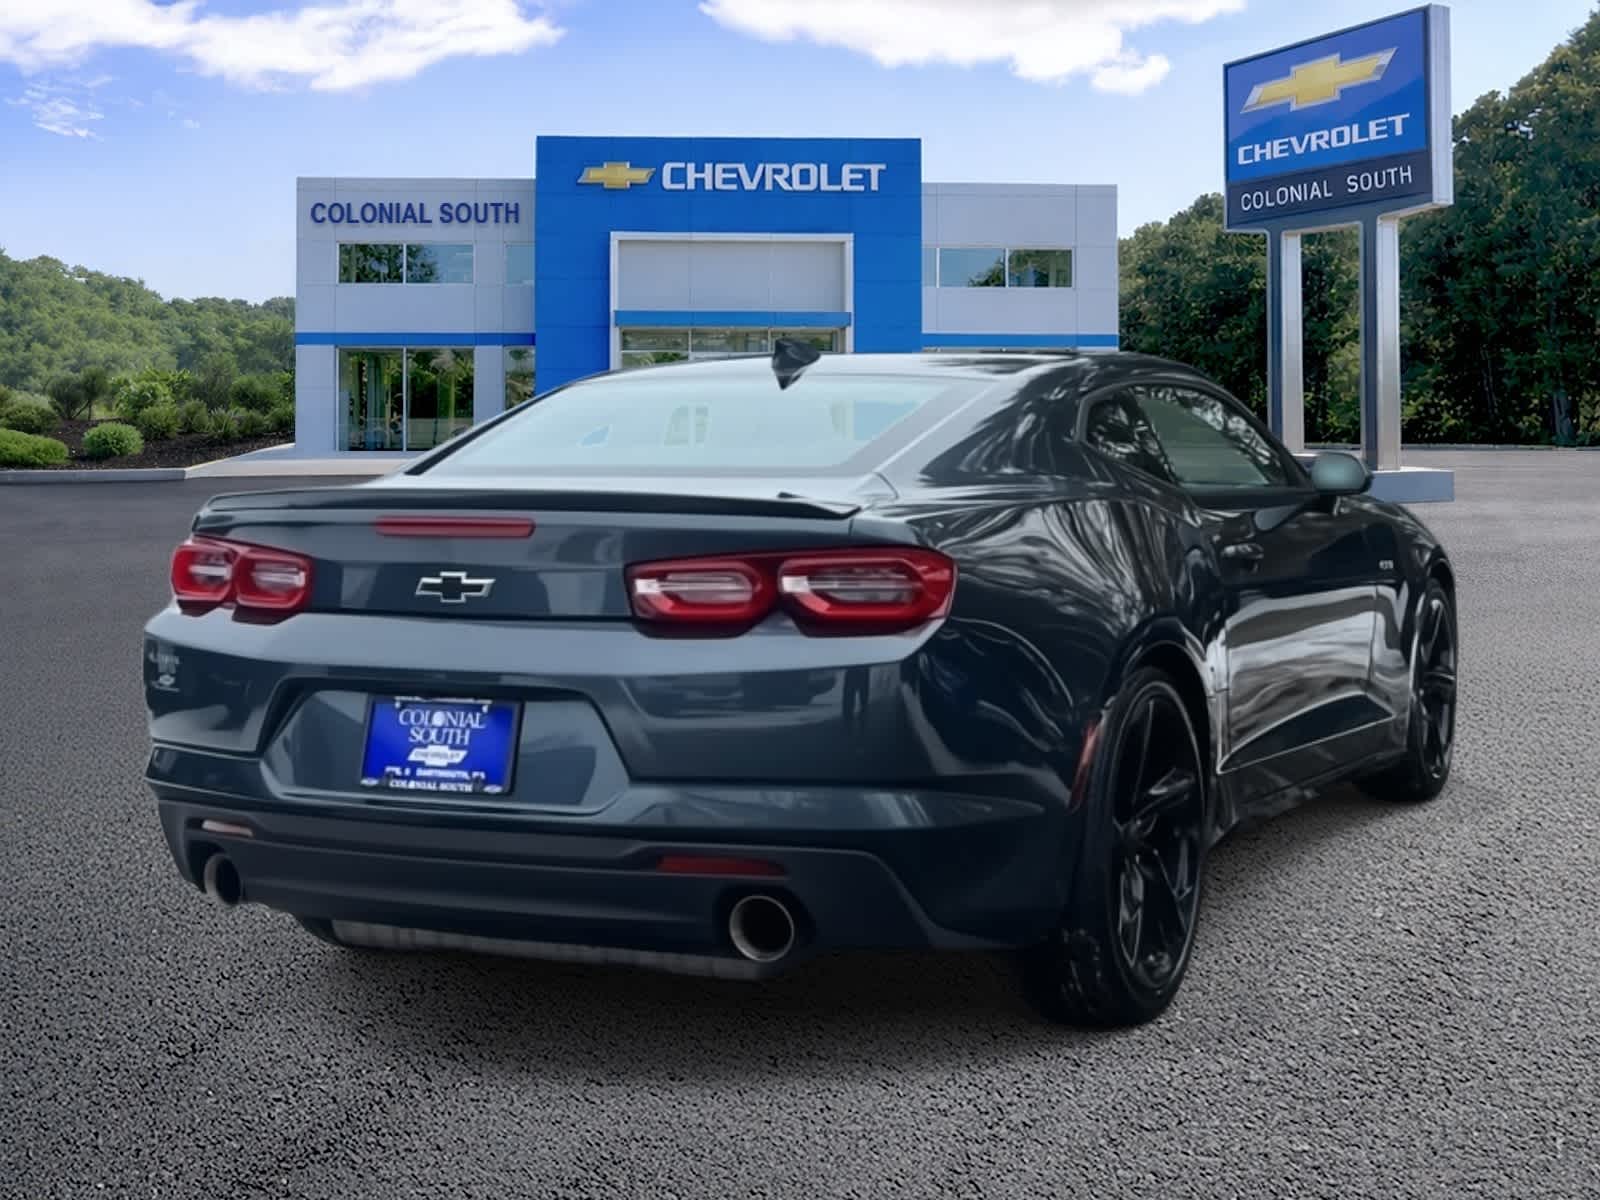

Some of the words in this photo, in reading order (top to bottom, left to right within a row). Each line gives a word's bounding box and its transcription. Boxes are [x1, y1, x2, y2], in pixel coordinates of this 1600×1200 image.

[1238, 113, 1410, 165] CHEVROLET
[661, 162, 887, 193] CHEVROLET
[1240, 179, 1333, 212] COLONIAL
[1346, 165, 1413, 193] SOUTH
[310, 202, 433, 225] COLONIAL
[439, 202, 520, 225] SOUTH
[398, 708, 486, 729] COLONIAL
[408, 726, 471, 745] SOUTH
